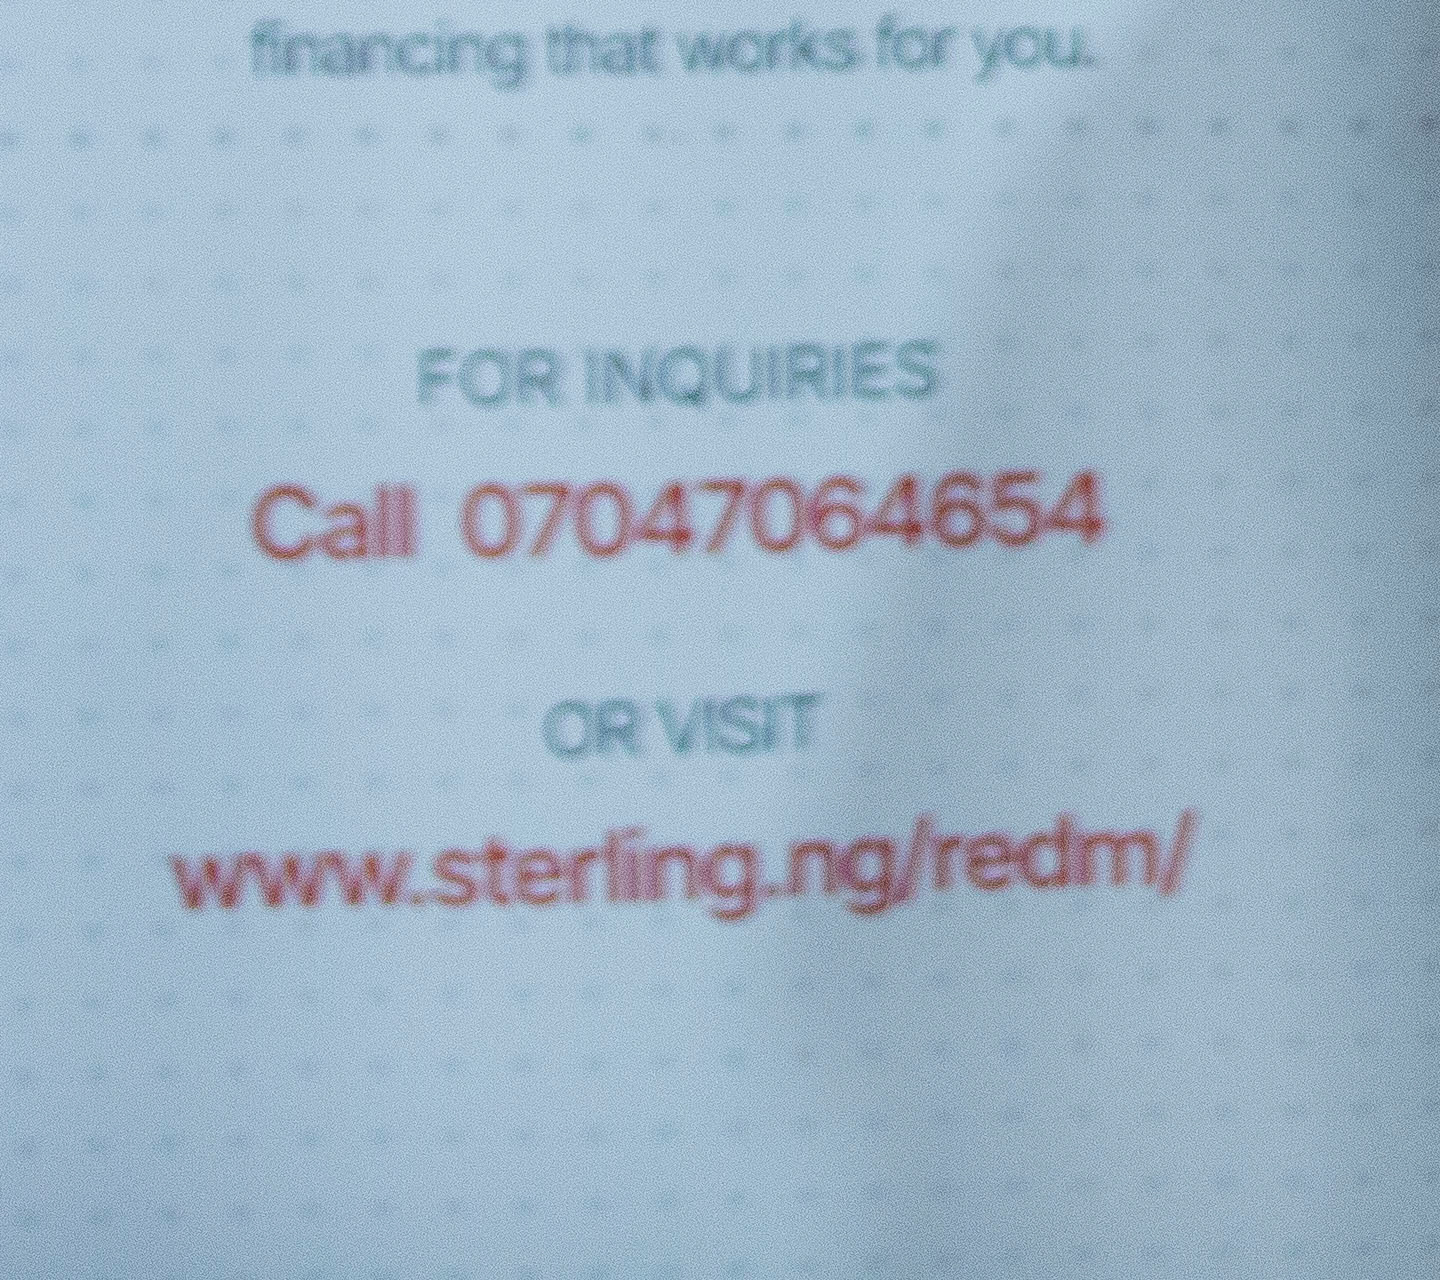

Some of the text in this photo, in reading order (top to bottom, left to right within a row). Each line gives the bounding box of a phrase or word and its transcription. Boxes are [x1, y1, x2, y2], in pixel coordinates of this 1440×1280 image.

[252, 11, 1099, 93] financing that works for you.
[416, 338, 943, 407] FOR INQUIRIES
[250, 468, 1107, 561] Call 07047064654
[541, 691, 823, 760] OR VISIT
[168, 806, 1198, 923] www.sterling.ng/redm/
